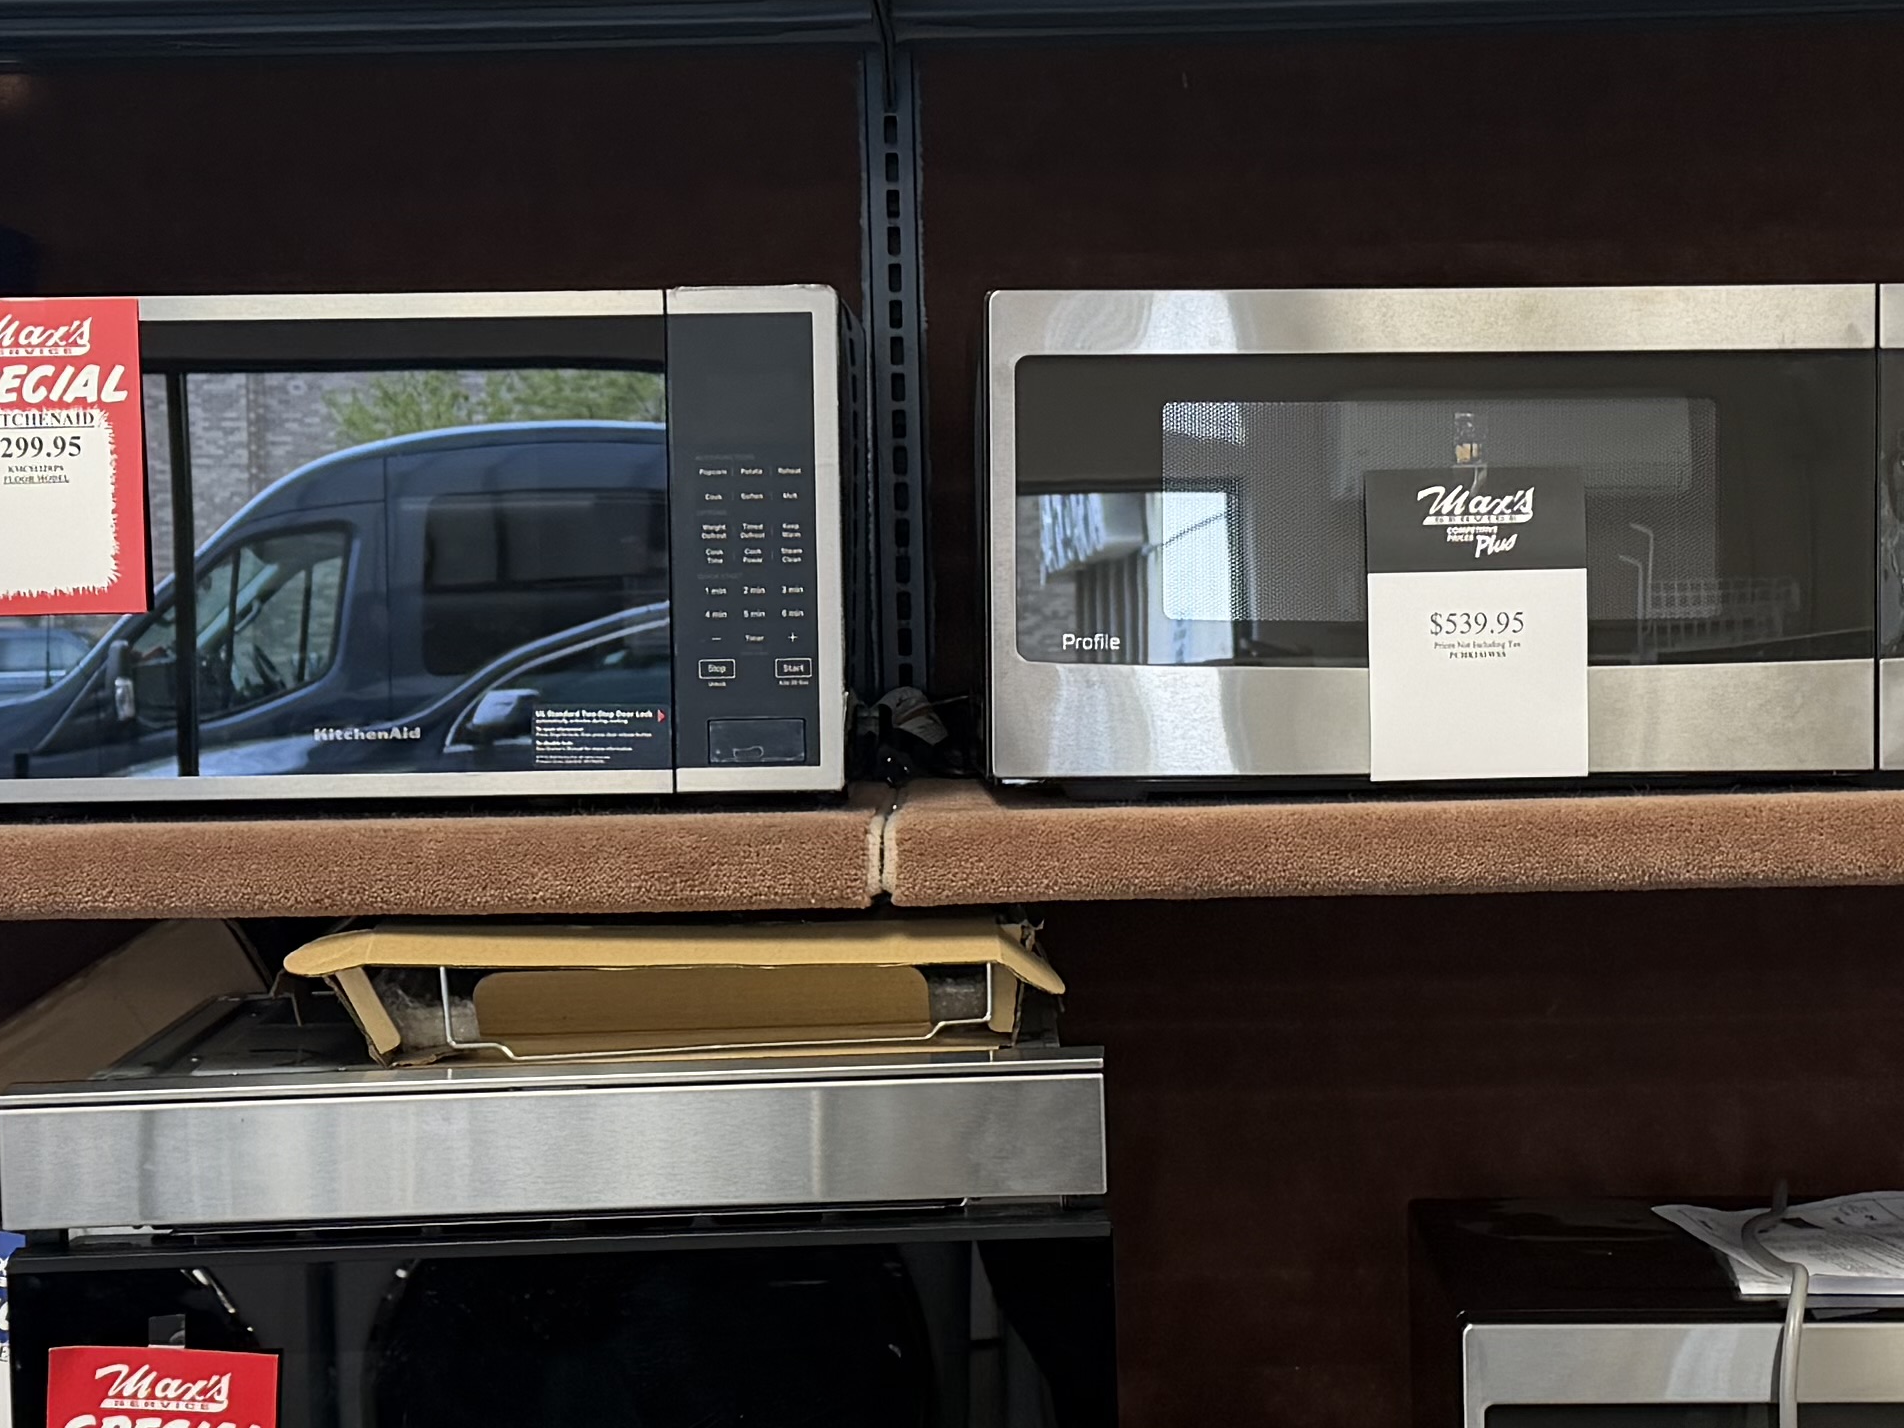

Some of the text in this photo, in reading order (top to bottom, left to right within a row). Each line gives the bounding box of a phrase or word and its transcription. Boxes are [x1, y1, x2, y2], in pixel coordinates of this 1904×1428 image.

[1430, 611, 1524, 637] $539.95
[1062, 633, 1120, 651] Profile
[314, 728, 421, 741] KitchenAid
